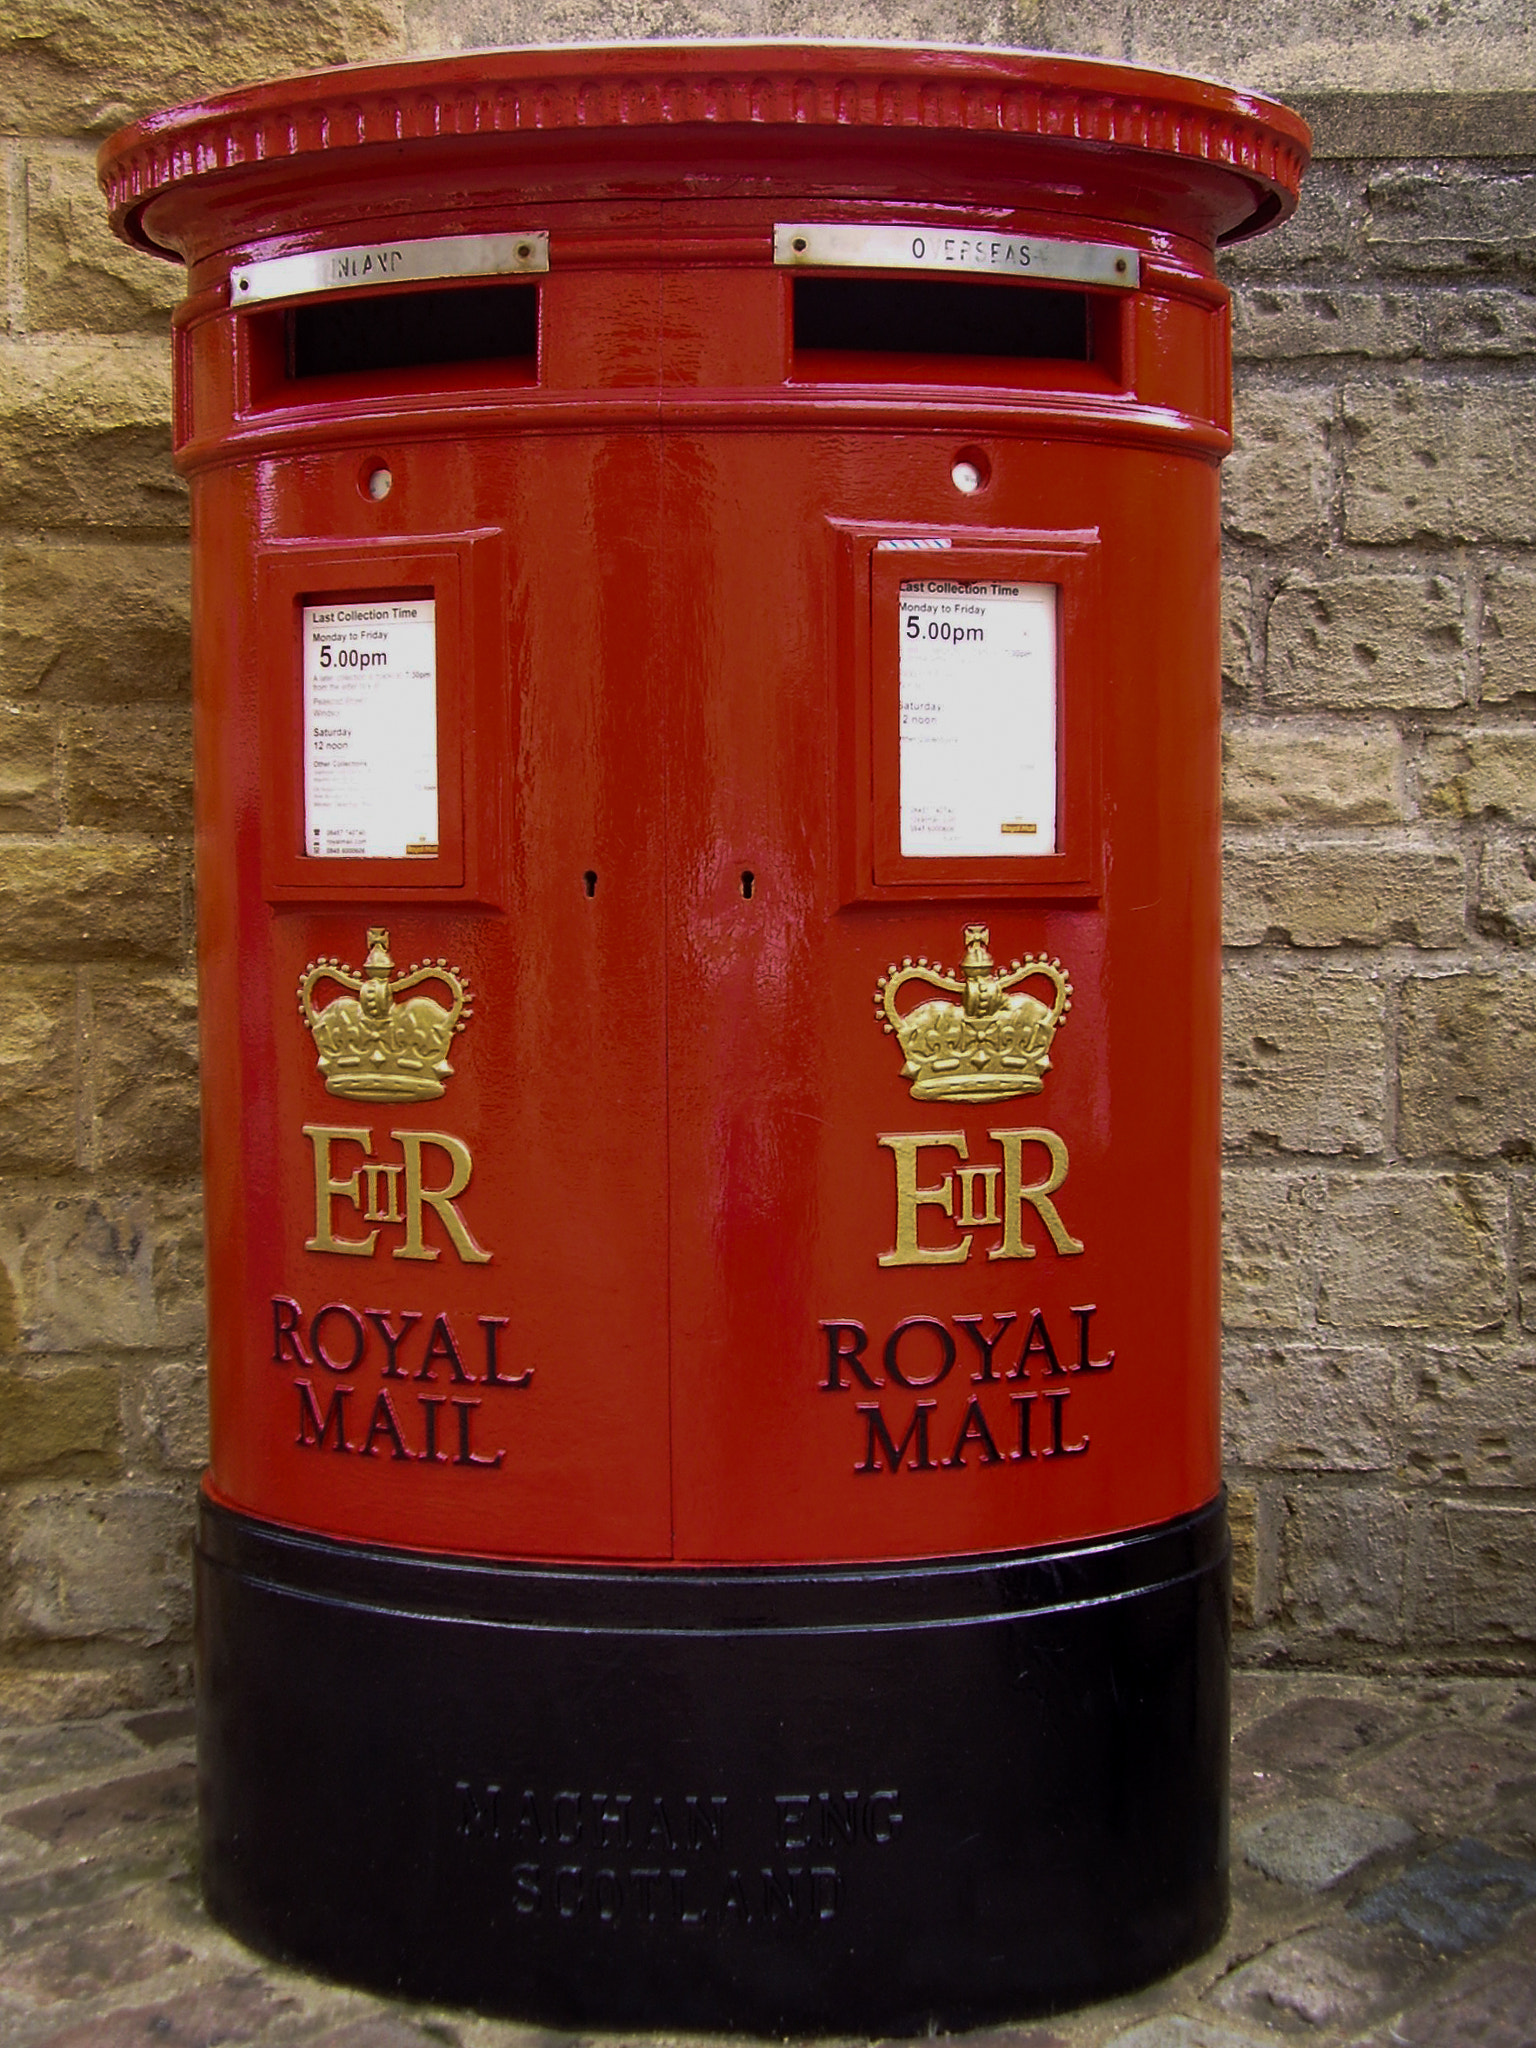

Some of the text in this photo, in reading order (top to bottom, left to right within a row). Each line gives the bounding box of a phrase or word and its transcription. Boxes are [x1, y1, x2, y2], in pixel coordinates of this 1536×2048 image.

[911, 237, 1032, 267] OERSEAS
[927, 581, 987, 595] Collection
[990, 584, 1019, 597] Time
[312, 607, 418, 623] Last Collection Time
[899, 602, 986, 617] Monday to Friday
[312, 630, 389, 643] Monday to Friday
[906, 615, 984, 645] 5.00pm
[319, 645, 388, 671] 5.00pm
[313, 728, 352, 738] Saturday
[313, 741, 349, 751] 12 noon
[271, 1295, 535, 1388] ROYAL
[817, 1303, 1115, 1391] ROYAL
[294, 1377, 507, 1468] MAIL
[853, 1387, 1090, 1473] MAIL
[455, 1780, 904, 1850] MACHAN ENG
[511, 1862, 846, 1922] SCOTLAND
